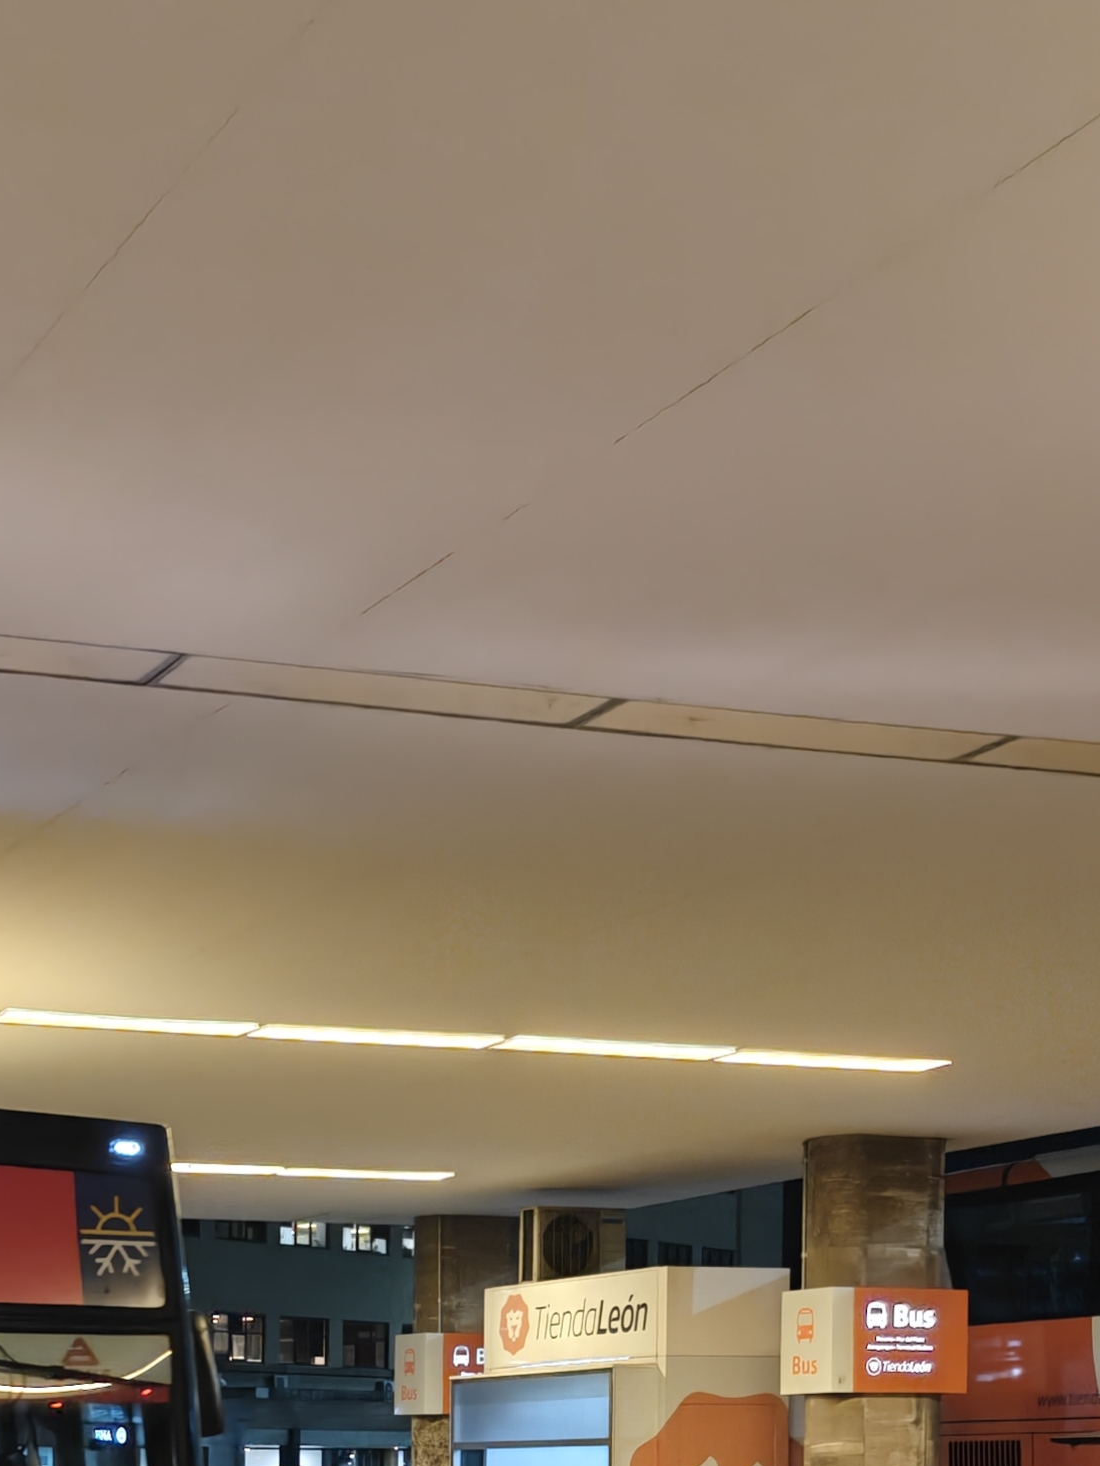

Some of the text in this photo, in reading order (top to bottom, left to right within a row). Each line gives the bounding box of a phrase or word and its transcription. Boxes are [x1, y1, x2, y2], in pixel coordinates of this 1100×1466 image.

[535, 1294, 648, 1341] TiendaLeón
[892, 1302, 937, 1330] Bus
[792, 1355, 818, 1375] Bus
[401, 1385, 418, 1401] Bus
